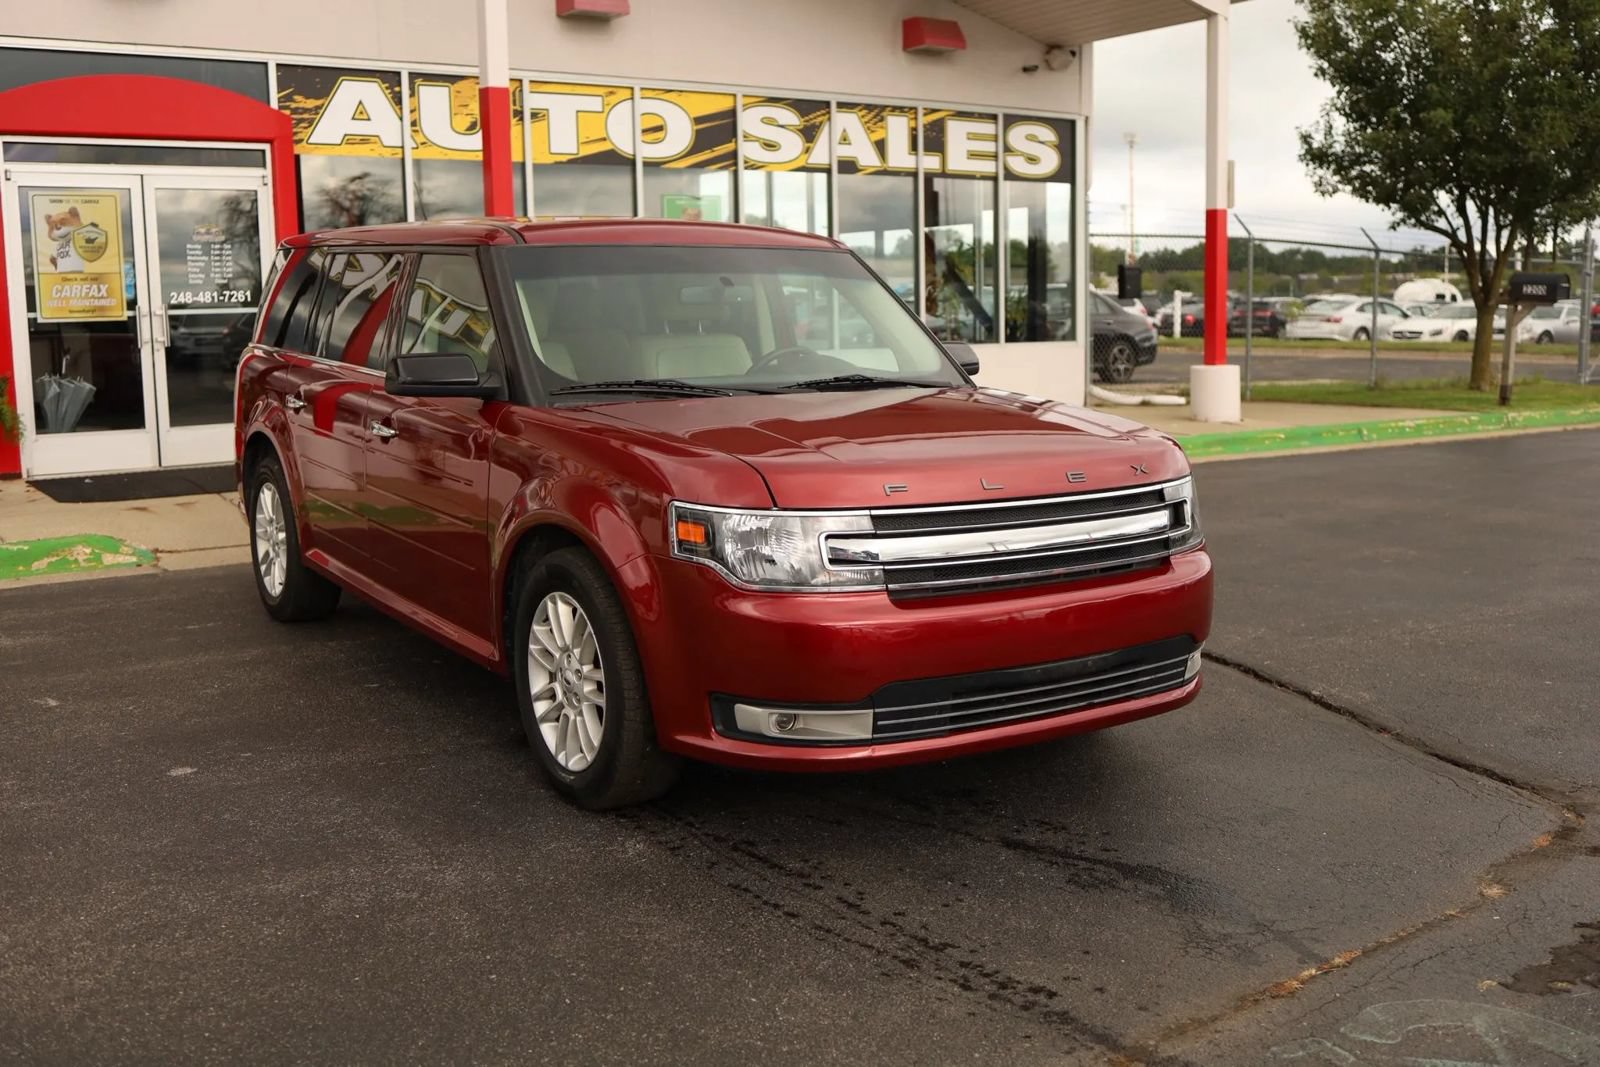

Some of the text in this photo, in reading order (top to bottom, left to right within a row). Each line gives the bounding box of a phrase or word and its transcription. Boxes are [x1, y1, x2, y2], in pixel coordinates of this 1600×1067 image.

[305, 76, 1062, 179] AUTO SALES
[53, 284, 108, 298] CARFAX
[170, 290, 251, 304] 248-481-7261
[883, 463, 1149, 497] FLEX
